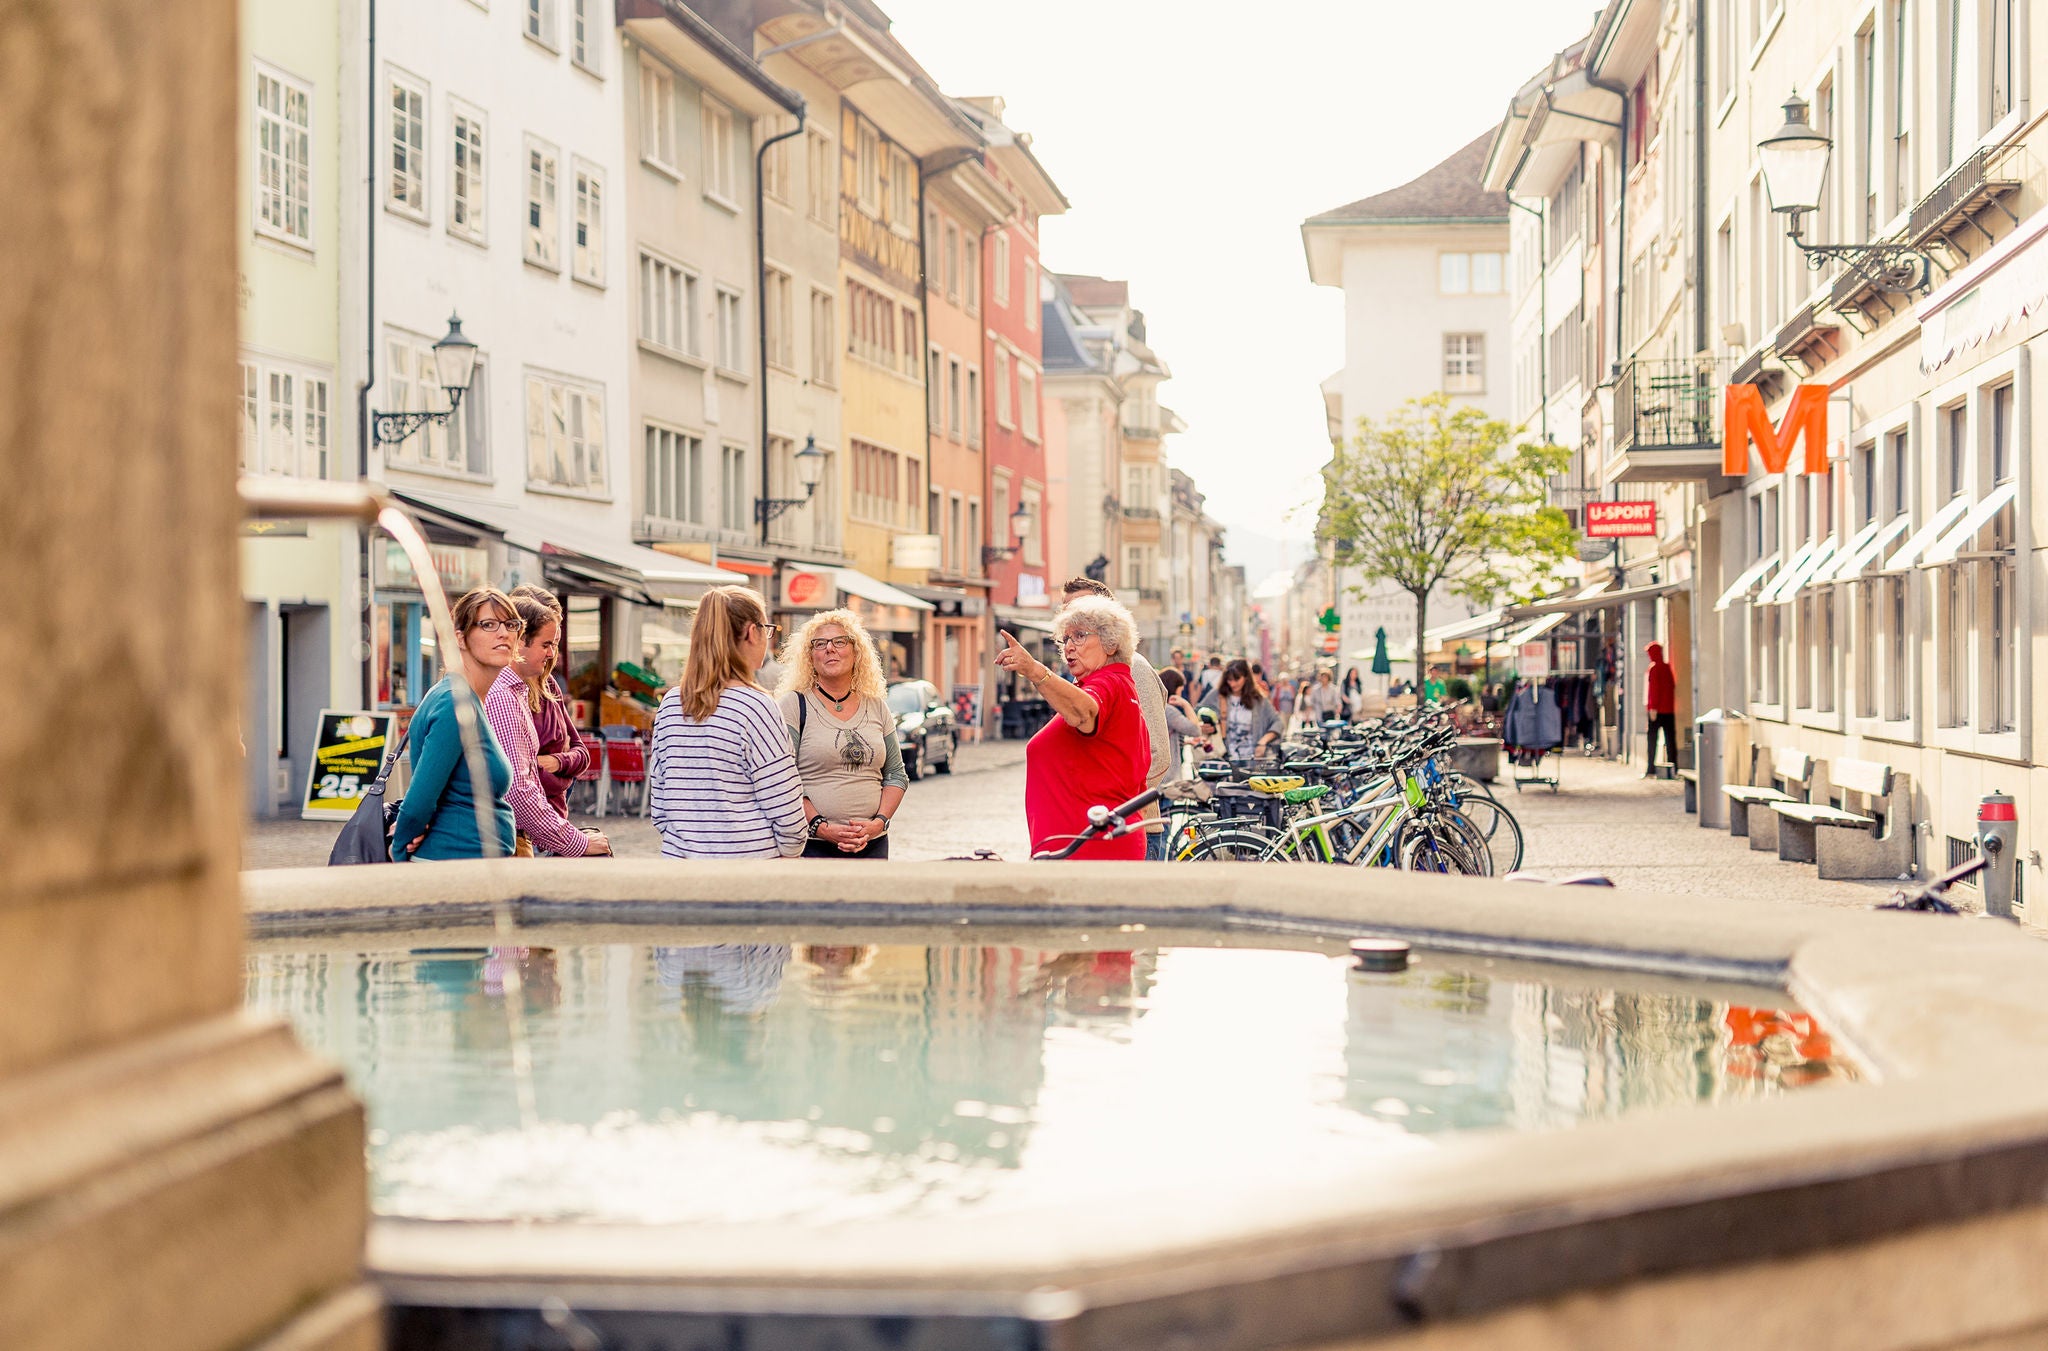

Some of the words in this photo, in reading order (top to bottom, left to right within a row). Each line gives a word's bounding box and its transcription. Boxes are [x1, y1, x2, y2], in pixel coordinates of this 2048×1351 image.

[1722, 383, 1829, 476] M
[1589, 505, 1652, 520] U-SPORT
[1591, 523, 1652, 534] WINTERTHUR
